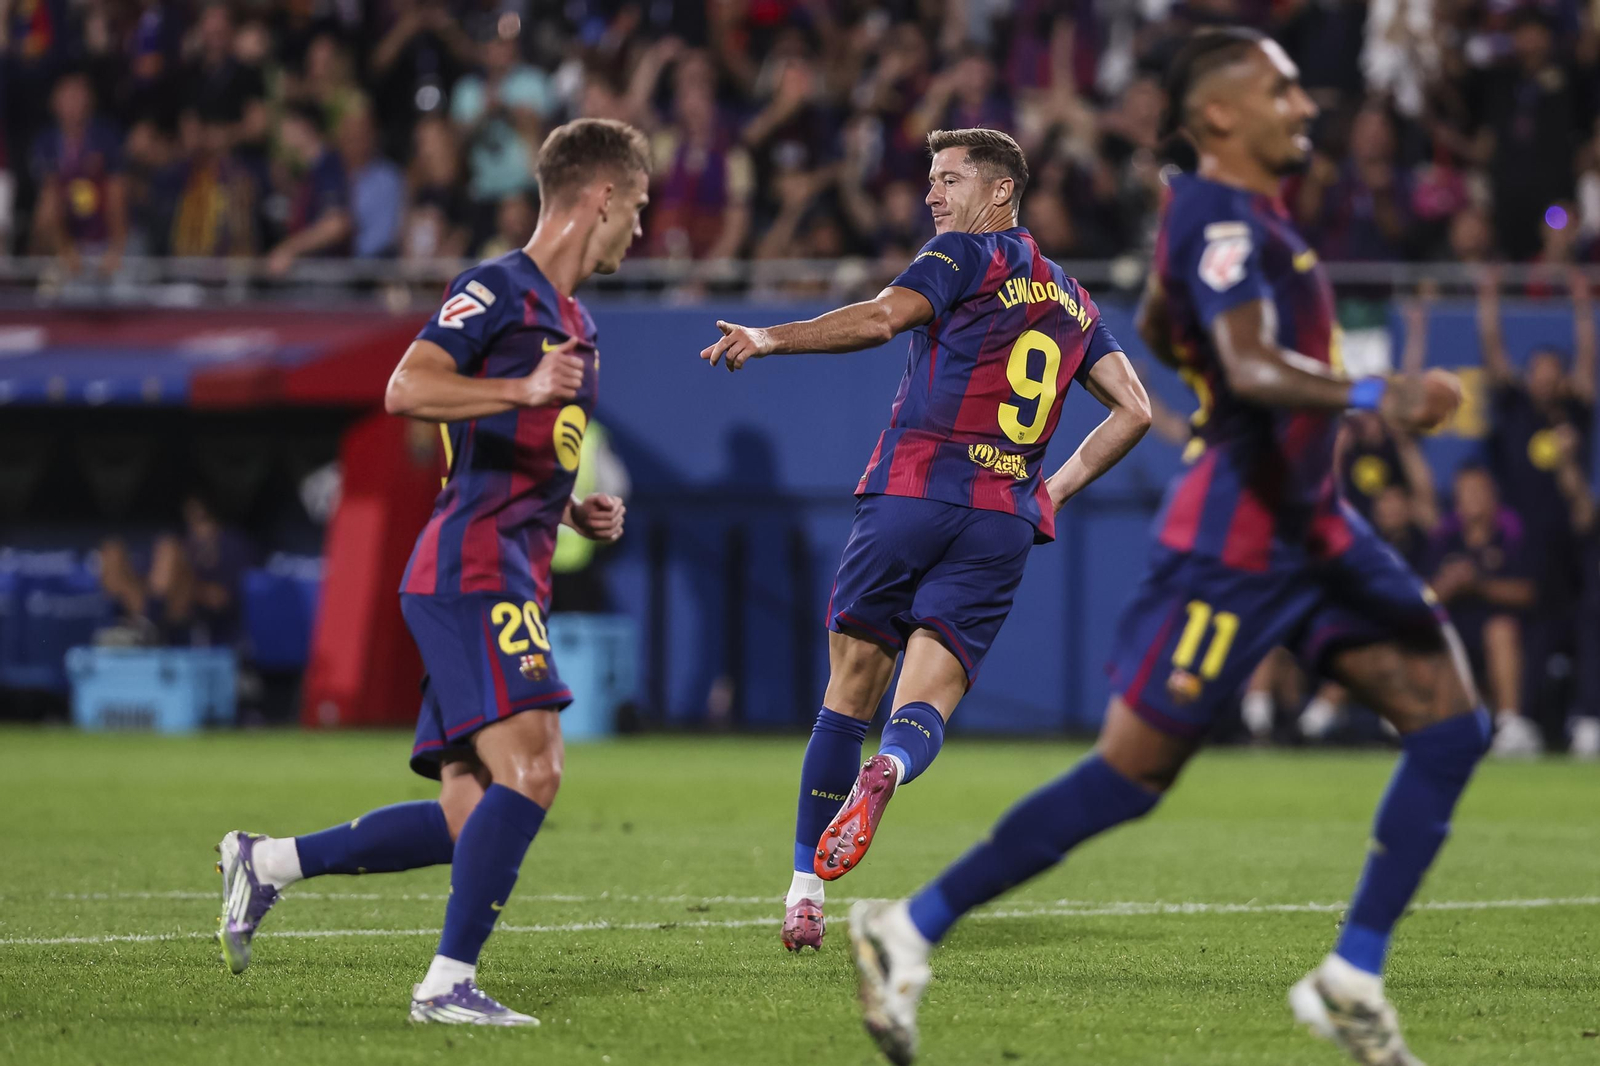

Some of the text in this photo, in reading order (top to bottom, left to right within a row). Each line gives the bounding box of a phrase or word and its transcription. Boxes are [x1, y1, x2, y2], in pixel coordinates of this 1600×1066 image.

[997, 277, 1092, 332] LEWDOWSKI
[998, 329, 1061, 444] 9
[994, 460, 1029, 479] ACNR
[490, 600, 551, 655] 20
[1171, 600, 1241, 679] 11
